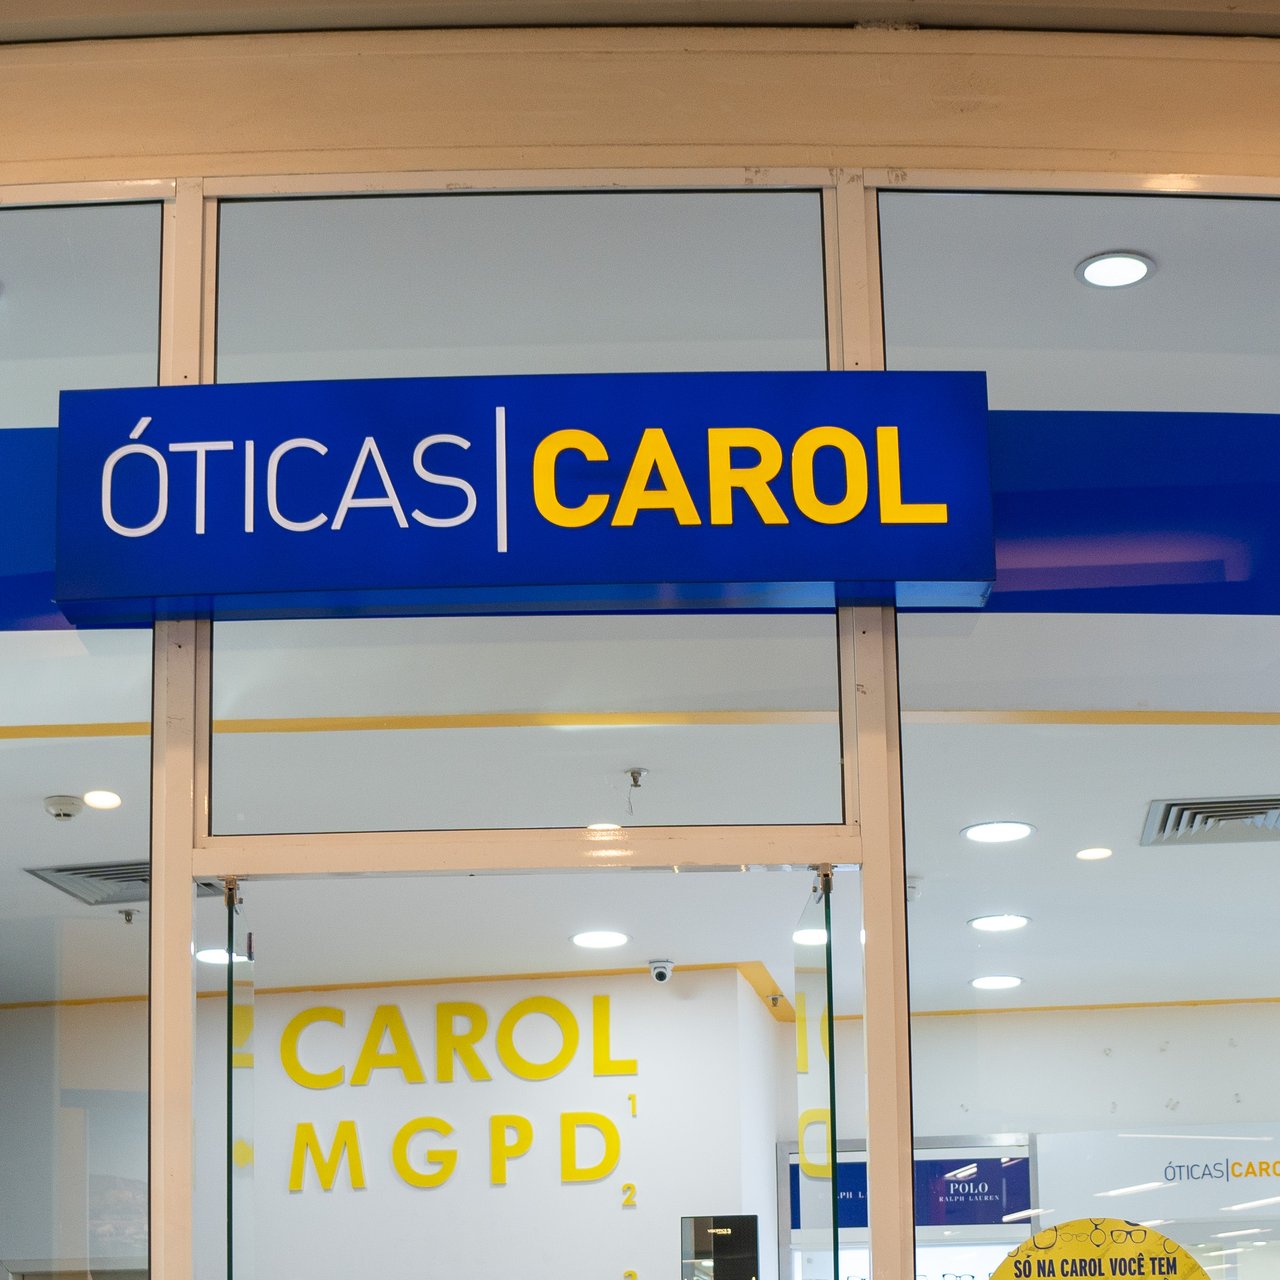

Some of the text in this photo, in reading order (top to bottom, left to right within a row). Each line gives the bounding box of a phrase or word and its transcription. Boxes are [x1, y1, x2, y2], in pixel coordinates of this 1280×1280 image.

[532, 425, 949, 527] CAROL
[280, 995, 639, 1090] CAROL
[621, 1184, 637, 1207] 2
[938, 1194, 1000, 1203] RALPH LAUREN
[949, 1182, 989, 1194] POLO
[1013, 1253, 1177, 1279] SÓ NA CAROL VOCÊ TEM
